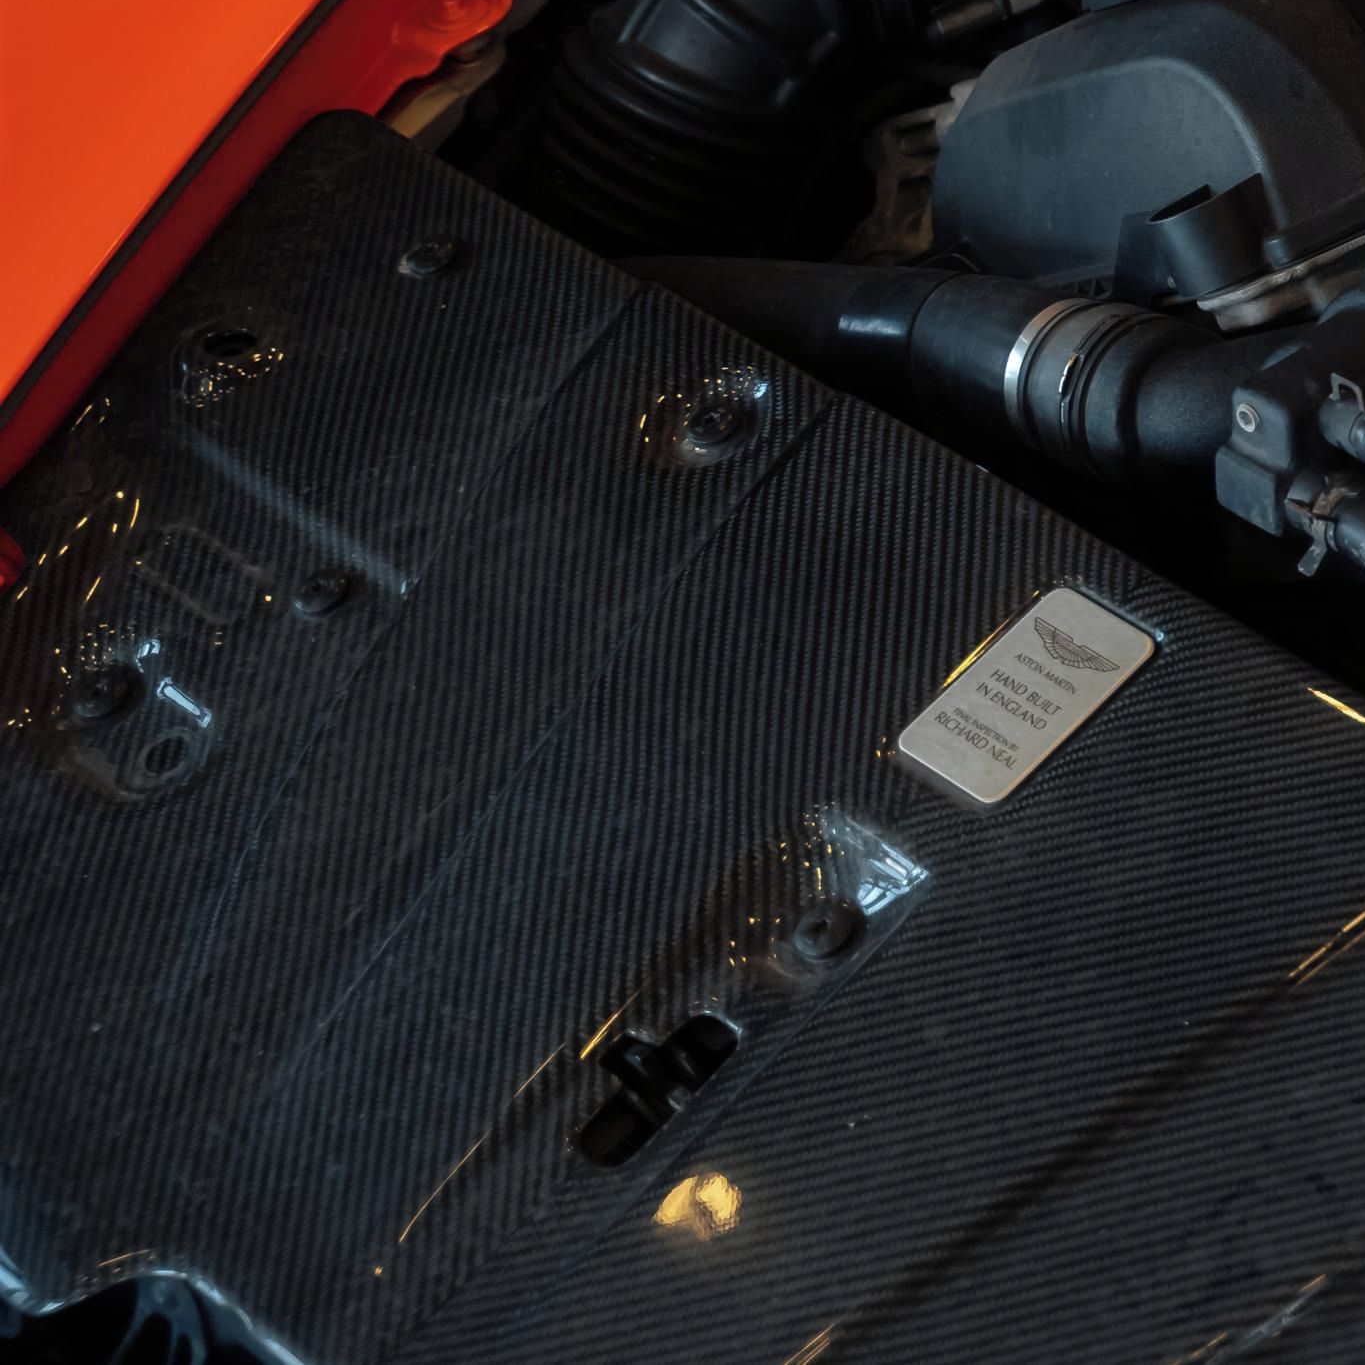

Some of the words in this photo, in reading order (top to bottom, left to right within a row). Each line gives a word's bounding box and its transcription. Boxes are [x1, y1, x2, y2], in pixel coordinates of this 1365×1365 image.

[990, 669, 1028, 695] HAND
[1025, 690, 1063, 716] BUILT
[1013, 653, 1045, 674] ASTON
[1043, 670, 1077, 695] MARTIN
[952, 707, 973, 723] FINAL
[972, 719, 1011, 747] INSPECTION
[975, 681, 993, 697] IN
[989, 690, 1048, 730] ENGLAND
[934, 711, 989, 749] RICHARD
[986, 744, 1019, 770] NEAL
